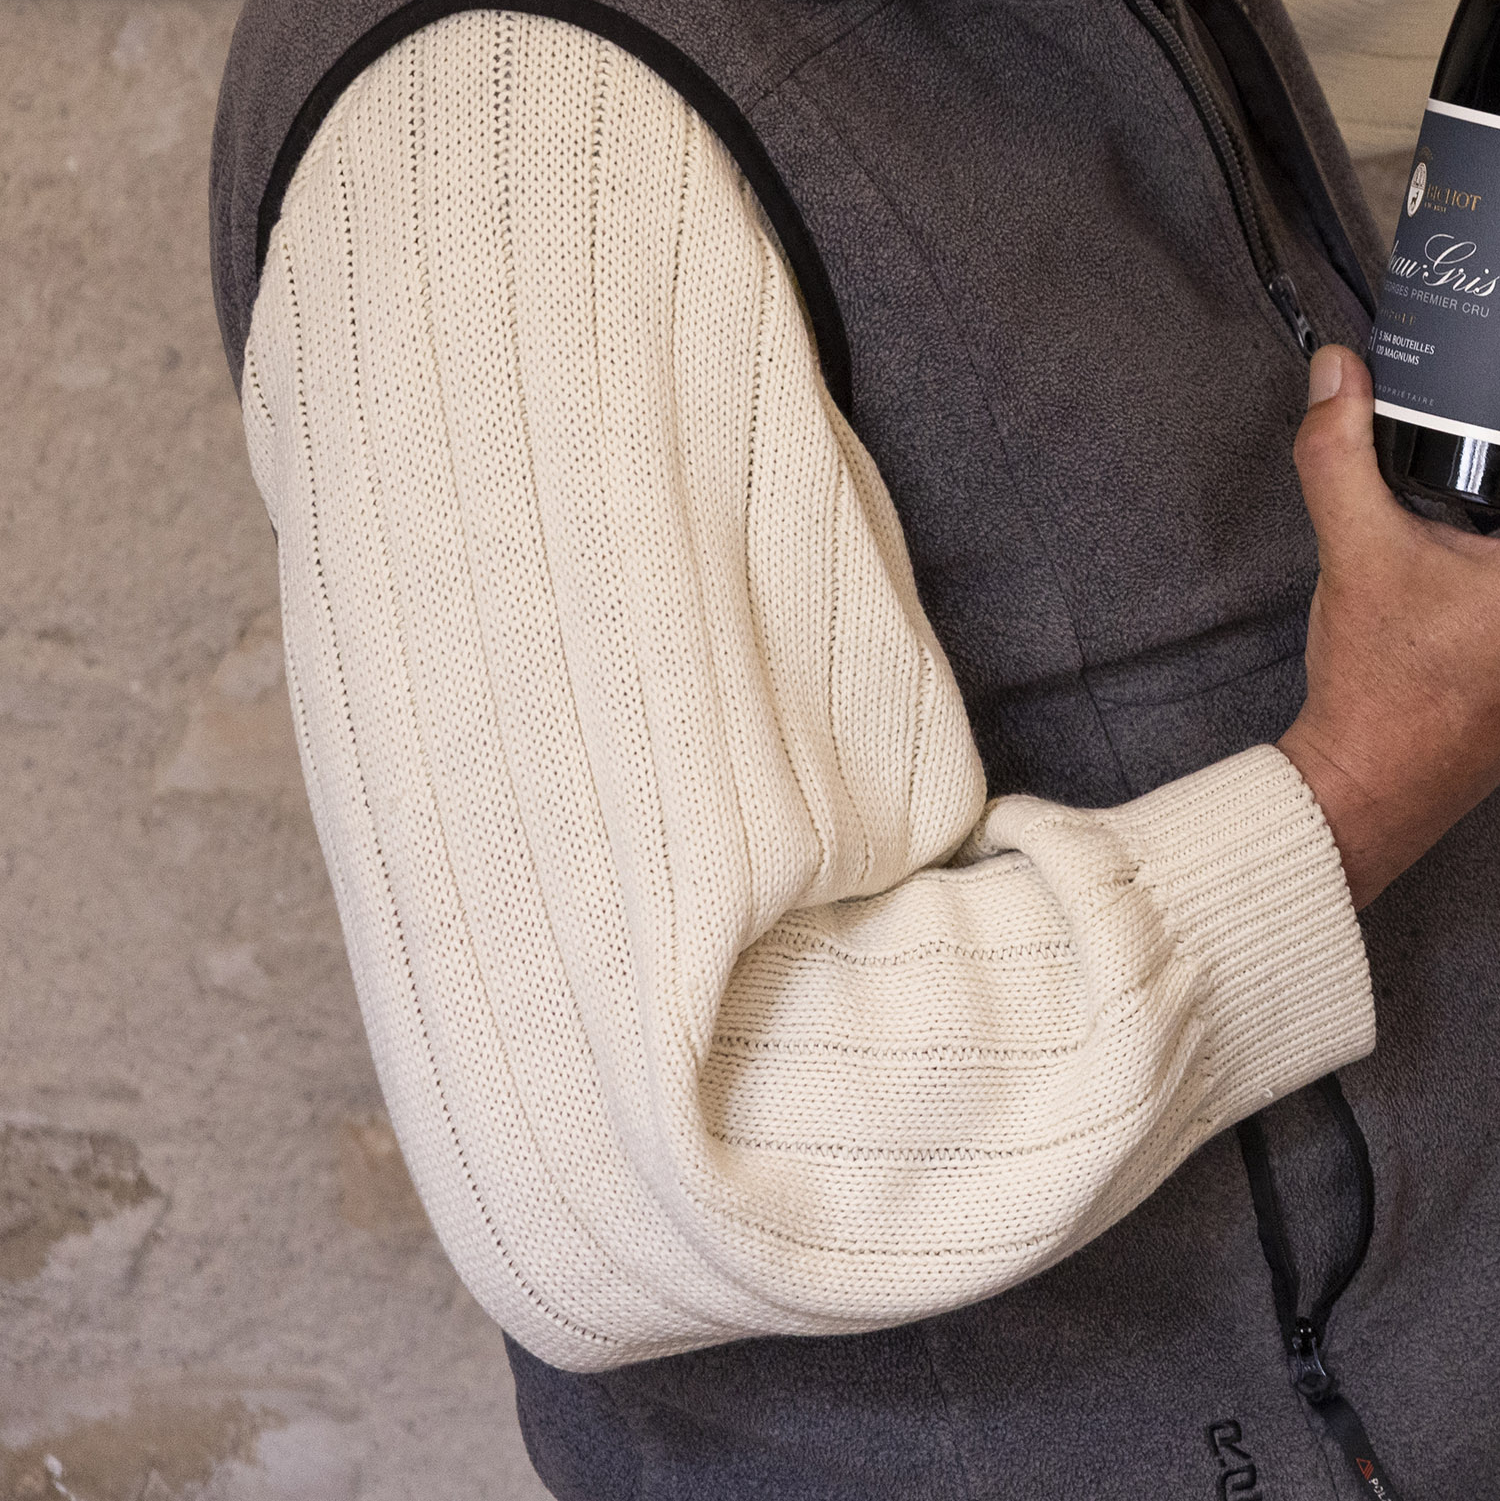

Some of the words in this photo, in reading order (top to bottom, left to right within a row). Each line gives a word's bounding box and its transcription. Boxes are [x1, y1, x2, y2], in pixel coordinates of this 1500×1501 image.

[1426, 184, 1482, 212] BICHOT
[1422, 233, 1500, 297] Gris
[1410, 287, 1459, 311] PREMIER
[1461, 301, 1491, 319] CRU
[1384, 348, 1421, 366] MAGNUMS
[1392, 334, 1436, 356] BOUTEILLES
